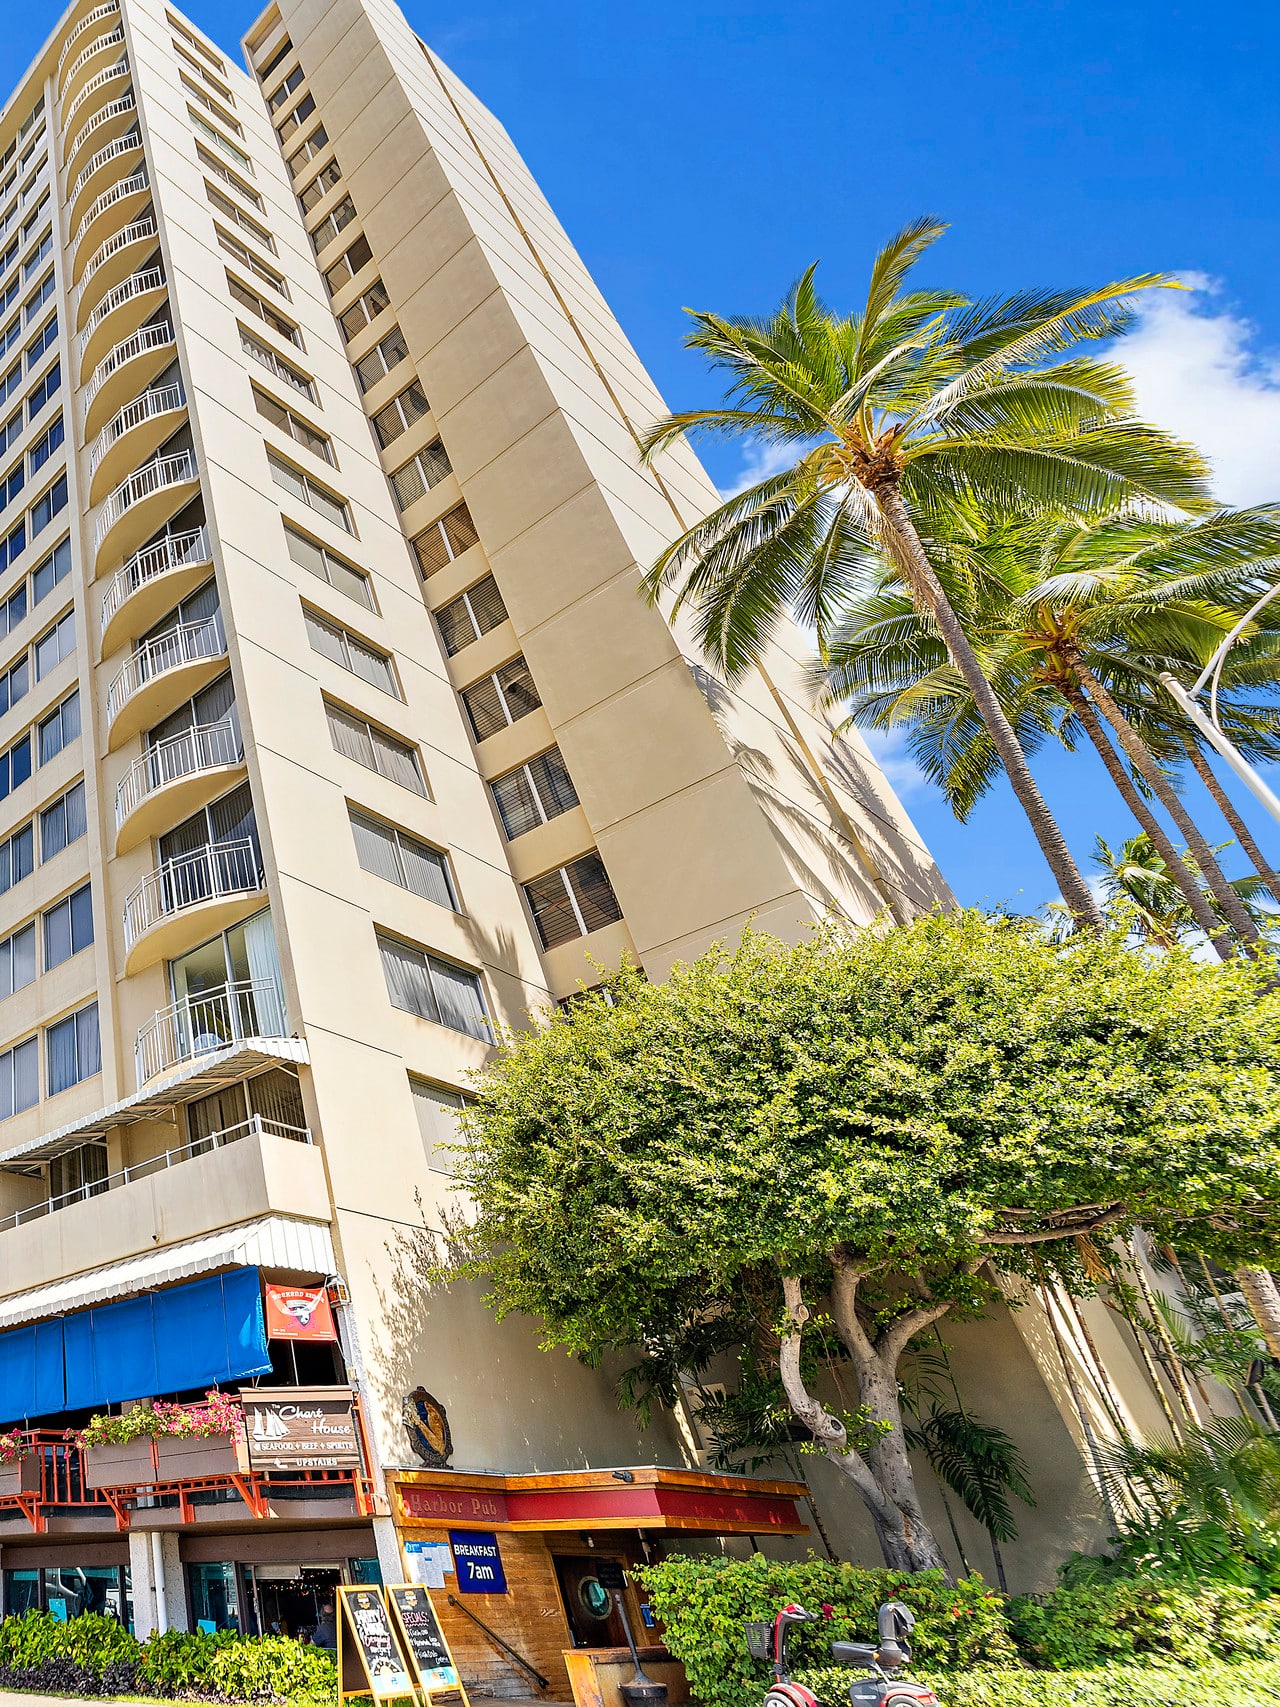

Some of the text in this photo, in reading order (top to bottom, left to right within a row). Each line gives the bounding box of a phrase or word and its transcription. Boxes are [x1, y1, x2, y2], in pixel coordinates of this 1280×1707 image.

[279, 1405, 323, 1420] Chart
[311, 1418, 351, 1434] House
[261, 1441, 354, 1450] SEAFOOD BEEF SPIRITS
[296, 1457, 338, 1467] UPSTAIRS
[411, 1494, 497, 1516] Harbor Pub
[453, 1544, 497, 1557] BREAKFAST
[466, 1561, 495, 1580] 7am
